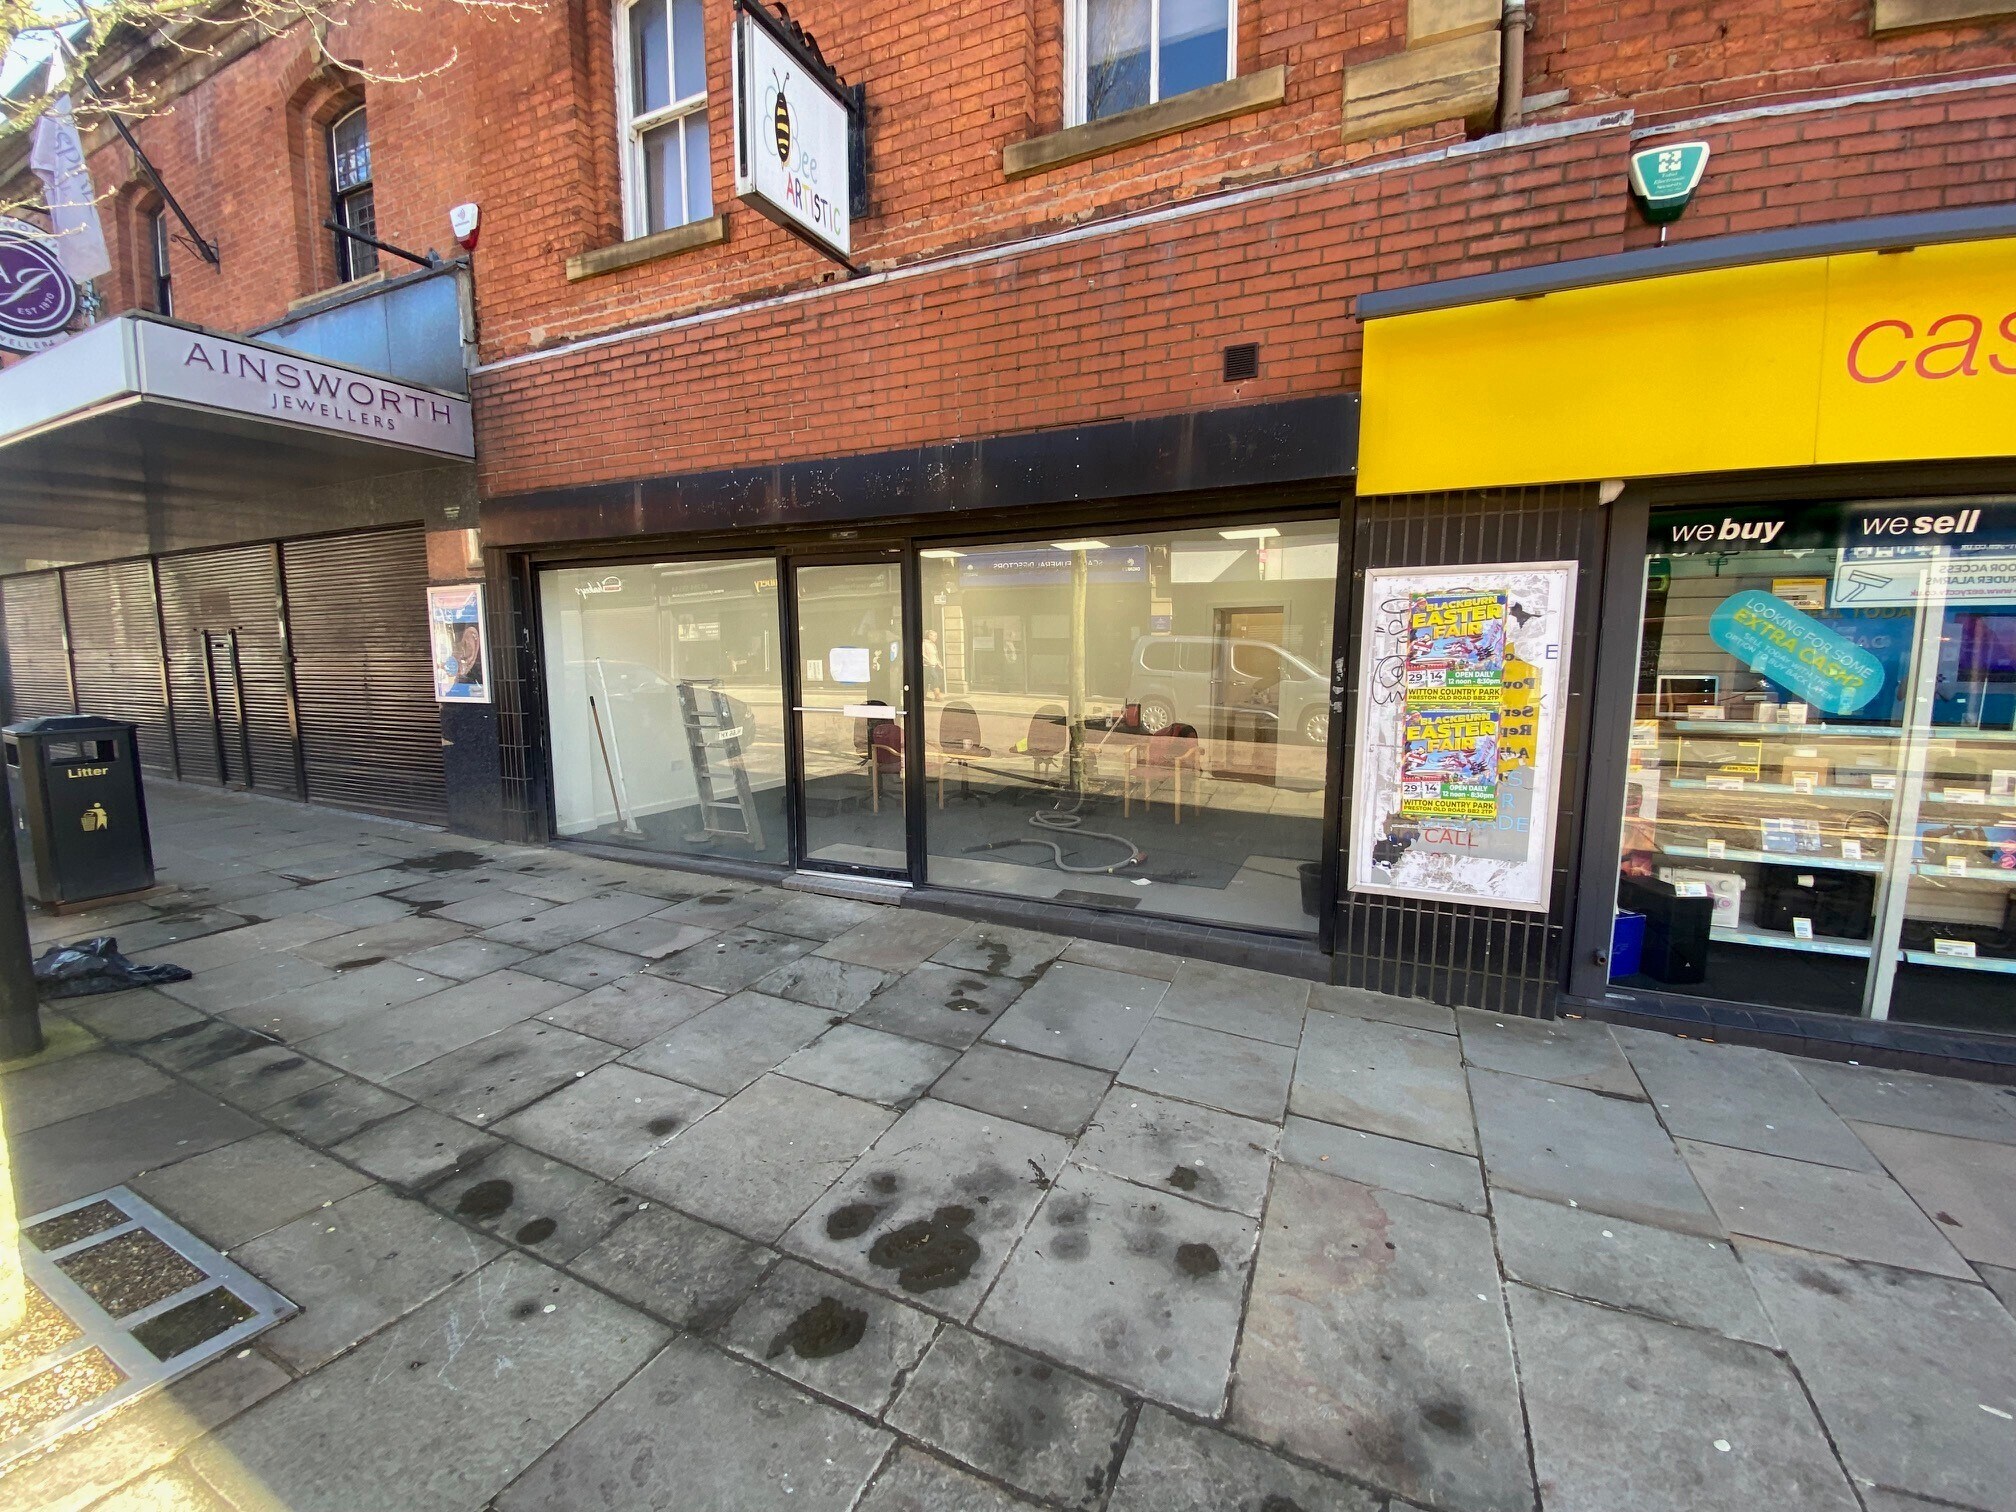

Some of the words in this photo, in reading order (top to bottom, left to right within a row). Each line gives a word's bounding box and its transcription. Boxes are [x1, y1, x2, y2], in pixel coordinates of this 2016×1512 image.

[786, 172, 841, 236] ARTISTIC
[184, 342, 452, 425] AINSWORTH
[272, 393, 396, 430] JEWELLERS
[1672, 525, 1715, 542] we
[1717, 517, 1785, 544] buy
[1862, 517, 1908, 536] we
[1912, 509, 1981, 535] sell
[1426, 596, 1498, 612] BLACKBURN
[1412, 604, 1503, 628] EASTER
[1433, 621, 1484, 639] FAIR
[1733, 608, 1798, 654] EXTRA
[1746, 598, 1805, 637] LOOKING
[1803, 632, 1833, 654] FOR
[1832, 649, 1874, 679] SOME
[1725, 631, 1755, 653] OPTION
[1768, 657, 1785, 672] BUY
[1785, 668, 1808, 686] BACK
[1744, 632, 1761, 648] SELL
[1764, 645, 1791, 666] TODAY
[1408, 673, 1423, 681] 29
[1430, 672, 1442, 680] 14
[1420, 713, 1491, 726] BLACKBURN
[1406, 721, 1497, 740] EASTER
[1427, 738, 1477, 753] FAIR
[68, 766, 109, 779] Litter
[1404, 784, 1418, 792] 29
[1404, 799, 1433, 807] WITTON
[1435, 800, 1471, 808] COUNTRY
[1473, 802, 1494, 810] PARK
[1425, 828, 1479, 847] CALL
